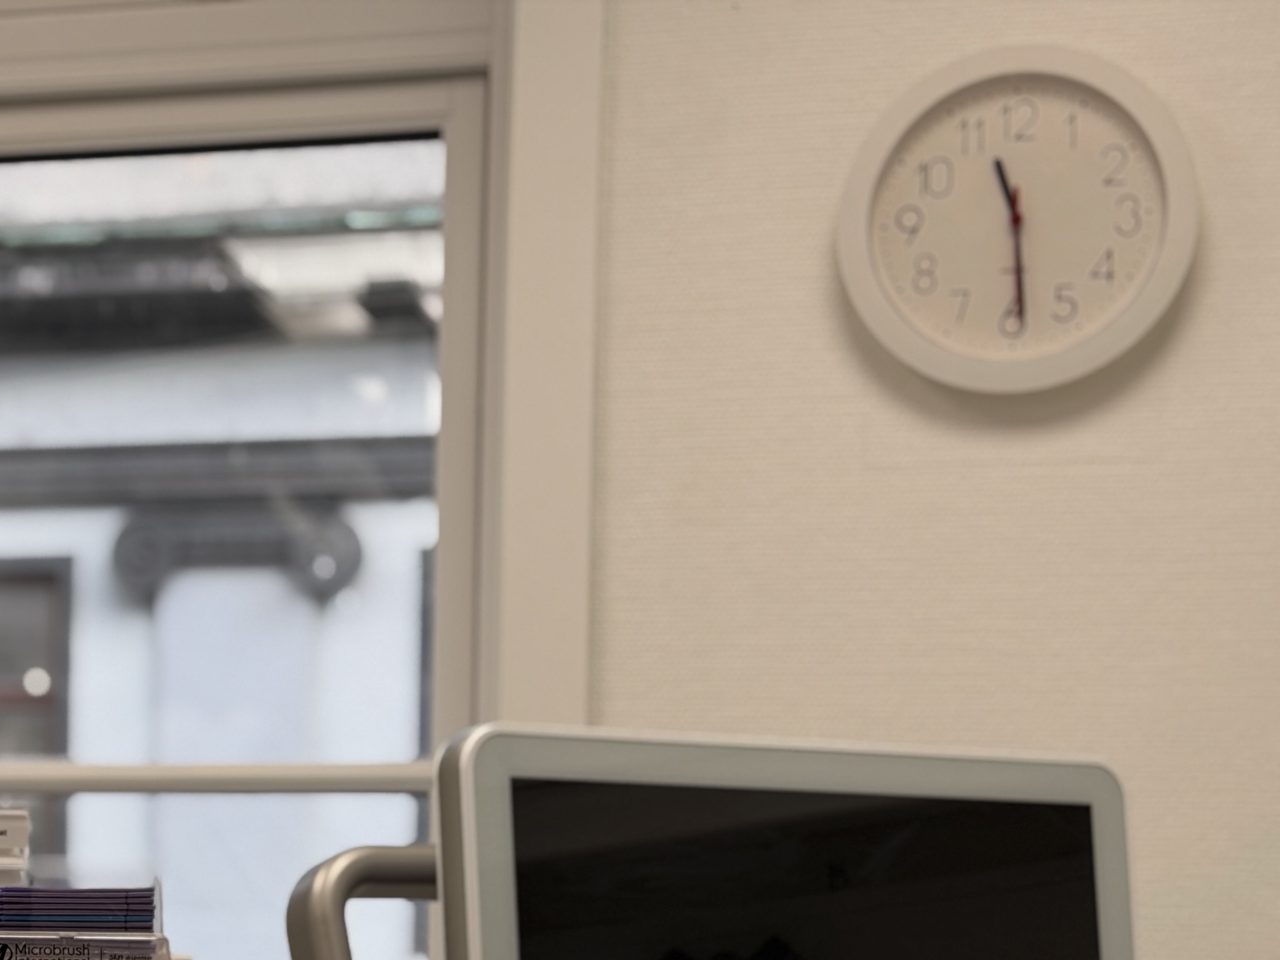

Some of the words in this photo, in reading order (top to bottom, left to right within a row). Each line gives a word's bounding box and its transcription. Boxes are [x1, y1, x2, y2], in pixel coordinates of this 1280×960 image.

[958, 117, 985, 154] 11
[1000, 97, 1040, 143] 12
[1065, 114, 1078, 149] 1
[916, 155, 955, 199] 10
[1101, 143, 1129, 187] 2
[894, 203, 924, 246] 9
[1114, 193, 1142, 238] 3
[912, 252, 938, 296] 8
[1089, 248, 1115, 283] 4
[949, 289, 971, 324] 7
[1050, 282, 1079, 324] 5
[15, 943, 90, 956] Microbrush
